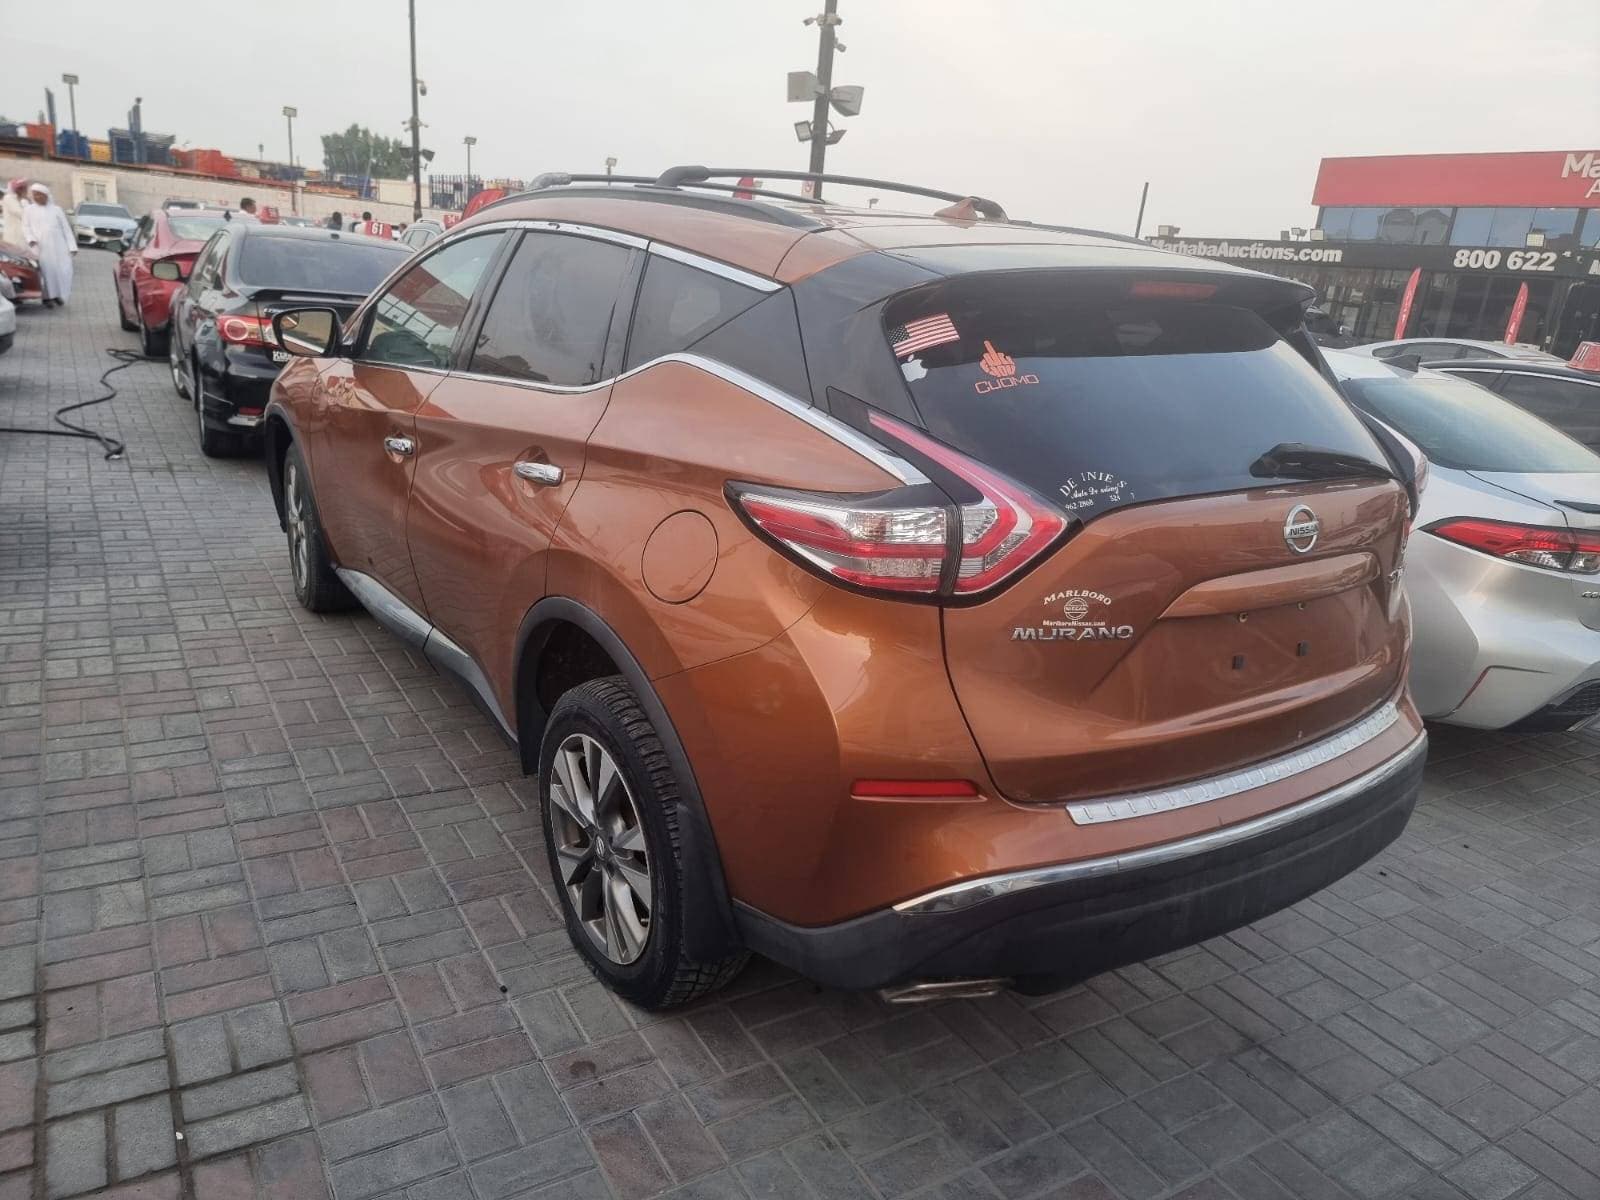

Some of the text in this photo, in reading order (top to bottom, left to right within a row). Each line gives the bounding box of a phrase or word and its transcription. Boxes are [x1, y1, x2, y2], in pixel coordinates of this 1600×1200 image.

[371, 222, 384, 235] 61
[1453, 249, 1557, 271] 800 622
[975, 374, 1040, 394] CUOMO
[1043, 589, 1112, 606] MARLBORO
[1010, 626, 1134, 641] MURANO
